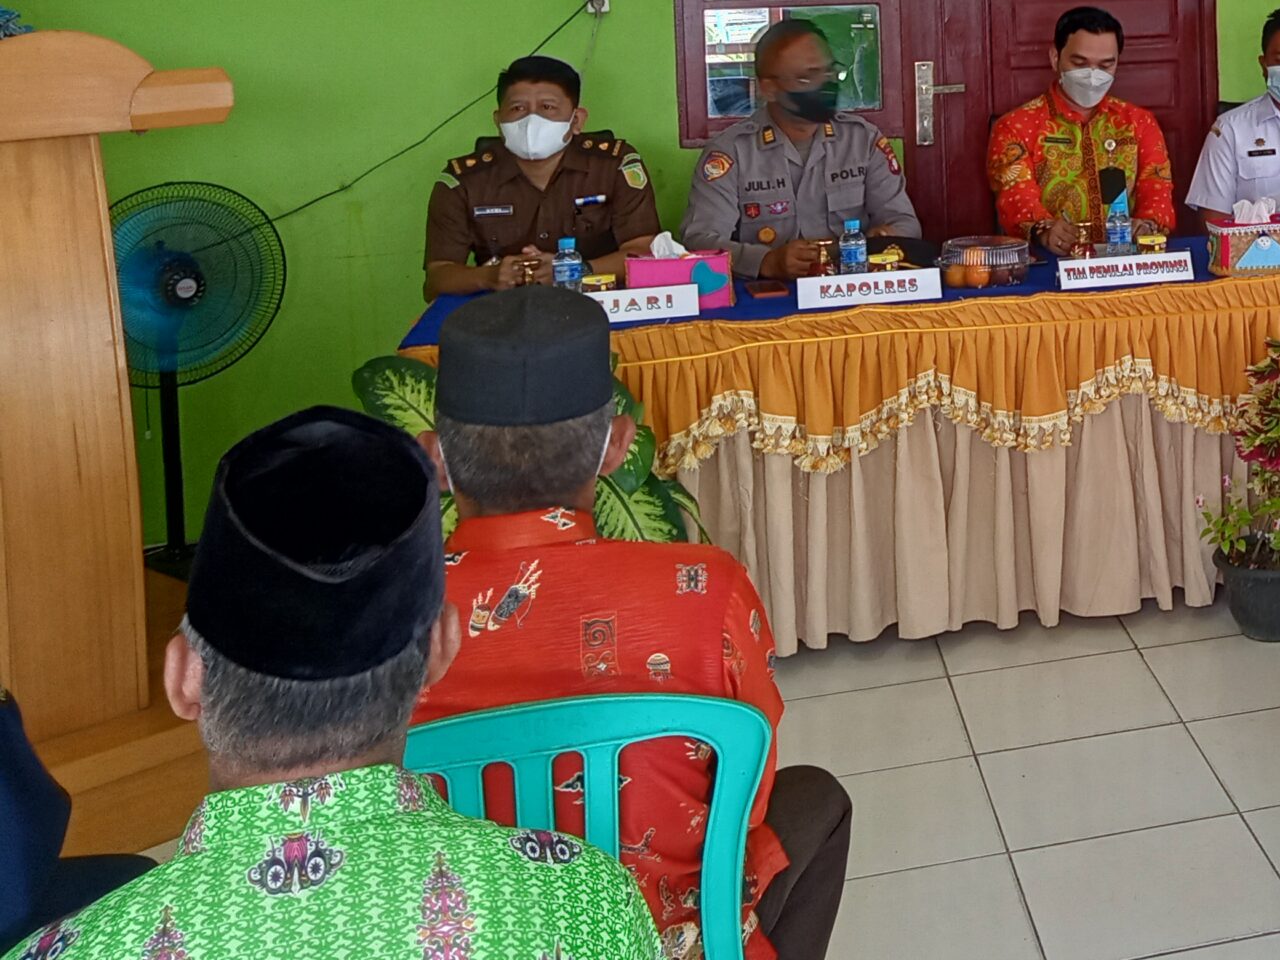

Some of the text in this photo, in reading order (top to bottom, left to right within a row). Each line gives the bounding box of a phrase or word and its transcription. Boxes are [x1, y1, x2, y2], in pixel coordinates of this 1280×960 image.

[1064, 266, 1088, 280] TIM
[1135, 259, 1189, 275] PROVINSI
[819, 278, 919, 299] KAPOLRES
[597, 293, 674, 314] JARI
